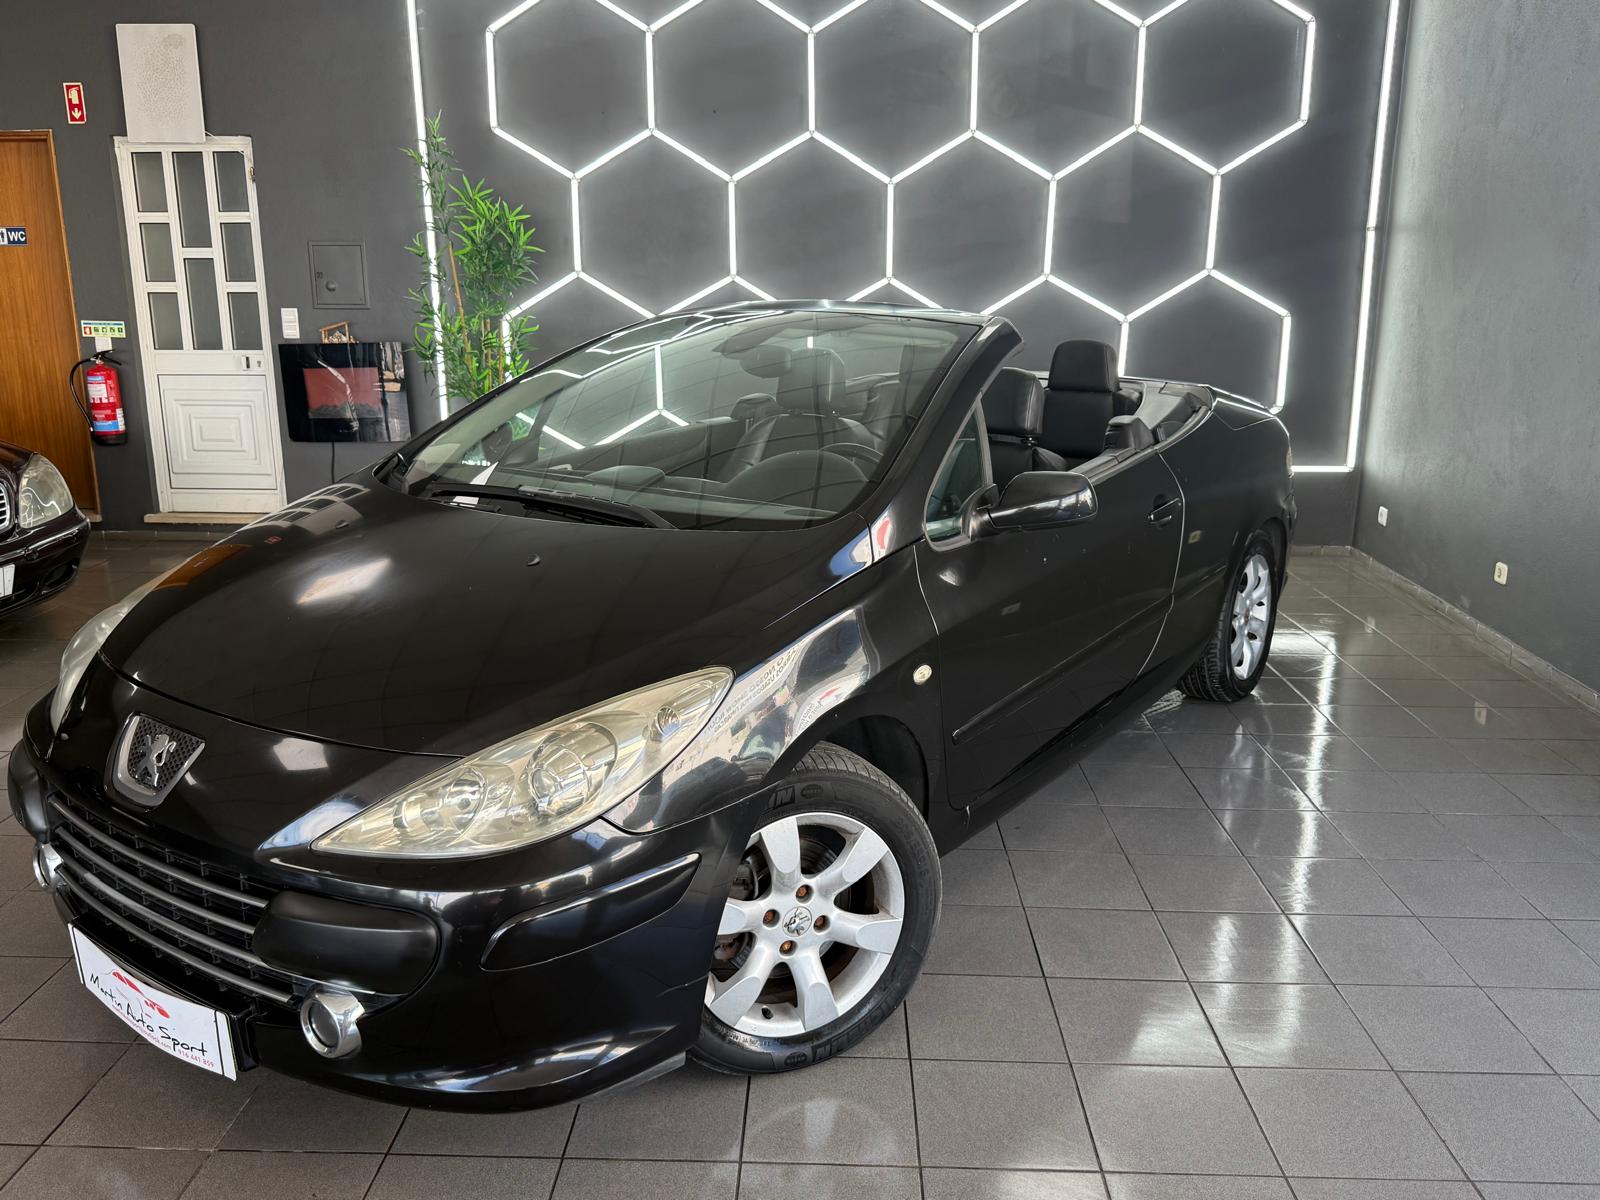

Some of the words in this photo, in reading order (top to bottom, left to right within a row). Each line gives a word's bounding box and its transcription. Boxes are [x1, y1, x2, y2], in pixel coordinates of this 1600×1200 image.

[8, 231, 26, 242] WC
[90, 973, 123, 1010] Martin
[127, 1003, 154, 1033] Auto
[159, 1026, 208, 1057] Sport
